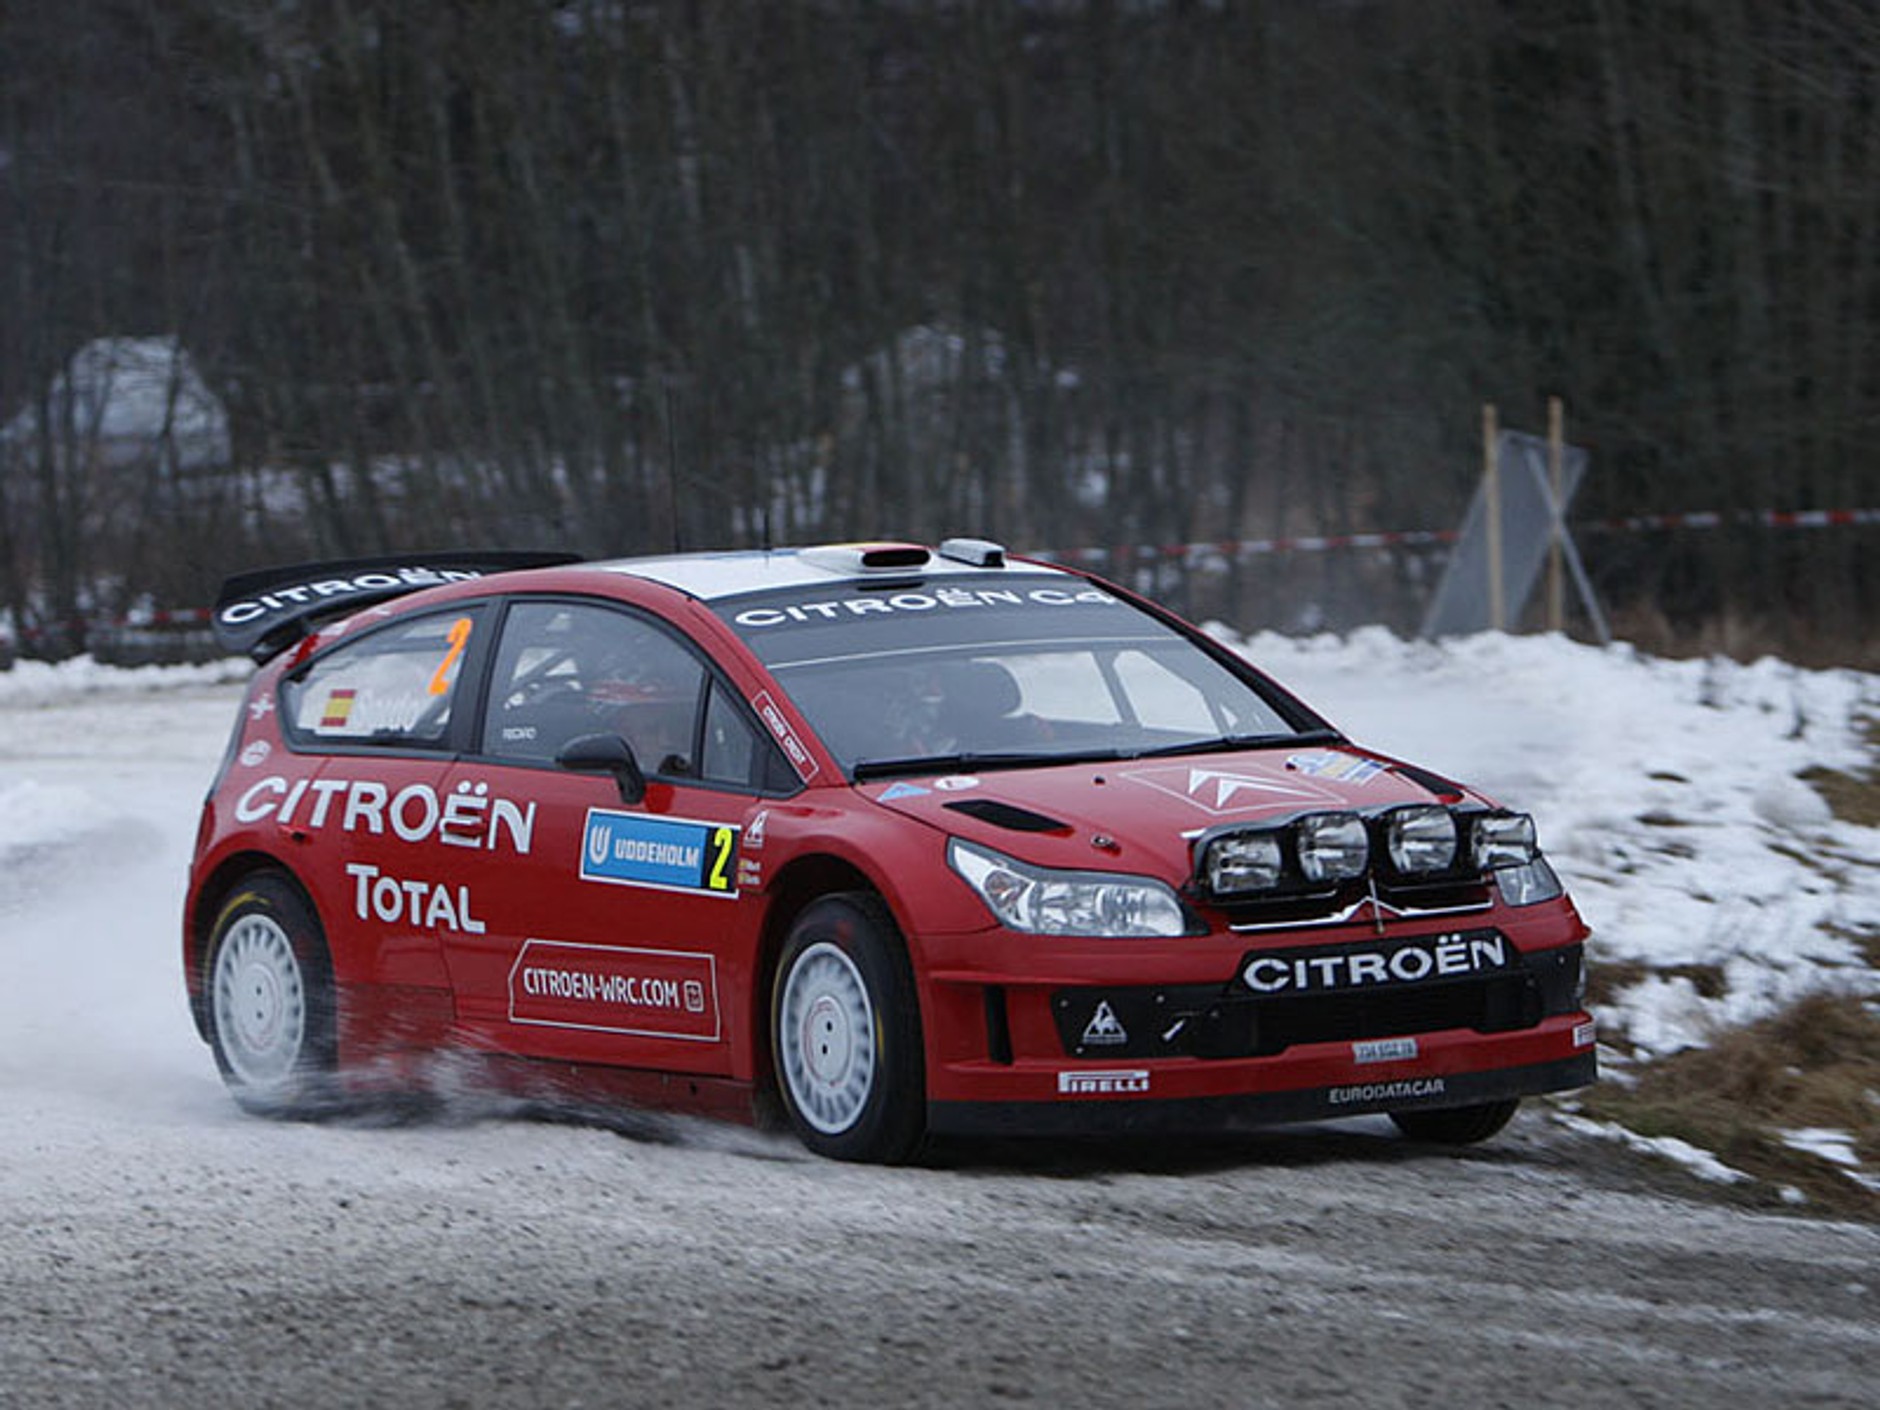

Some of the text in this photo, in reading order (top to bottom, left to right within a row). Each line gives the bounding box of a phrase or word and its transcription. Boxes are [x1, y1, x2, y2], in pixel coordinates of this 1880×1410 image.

[735, 588, 1023, 626] CITROËN
[429, 617, 473, 696] 2
[234, 776, 537, 855] CITROËN
[614, 826, 734, 891] UDDEHOLM 2
[345, 862, 487, 934] TOTAL
[522, 967, 681, 1008] CITROEN-WRC.COM
[1243, 932, 1505, 992] CITROËN
[1058, 1069, 1150, 1093] PIRELLI
[1328, 1078, 1446, 1104] EURODATACAR
